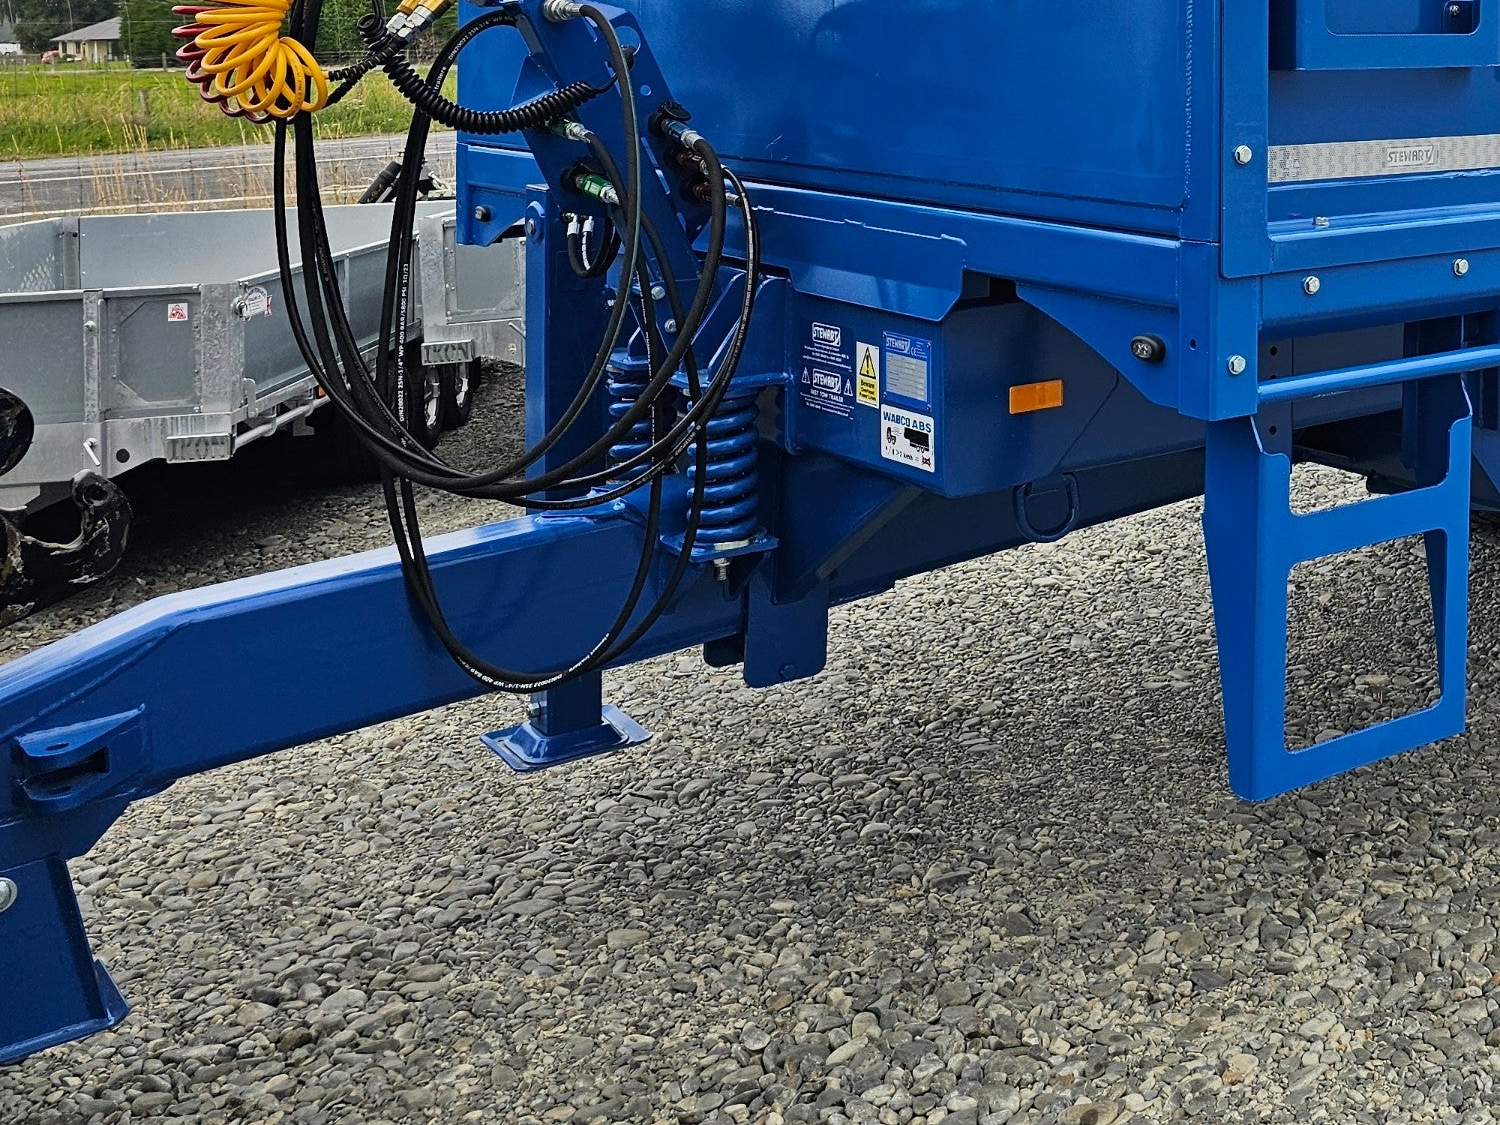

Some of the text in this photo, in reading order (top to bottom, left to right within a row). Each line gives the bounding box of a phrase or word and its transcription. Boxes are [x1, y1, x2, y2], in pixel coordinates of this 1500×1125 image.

[1386, 145, 1434, 165] STEWART
[813, 326, 840, 345] STEWART
[813, 372, 840, 392] STEWART
[883, 410, 932, 433] WABCO ABS
